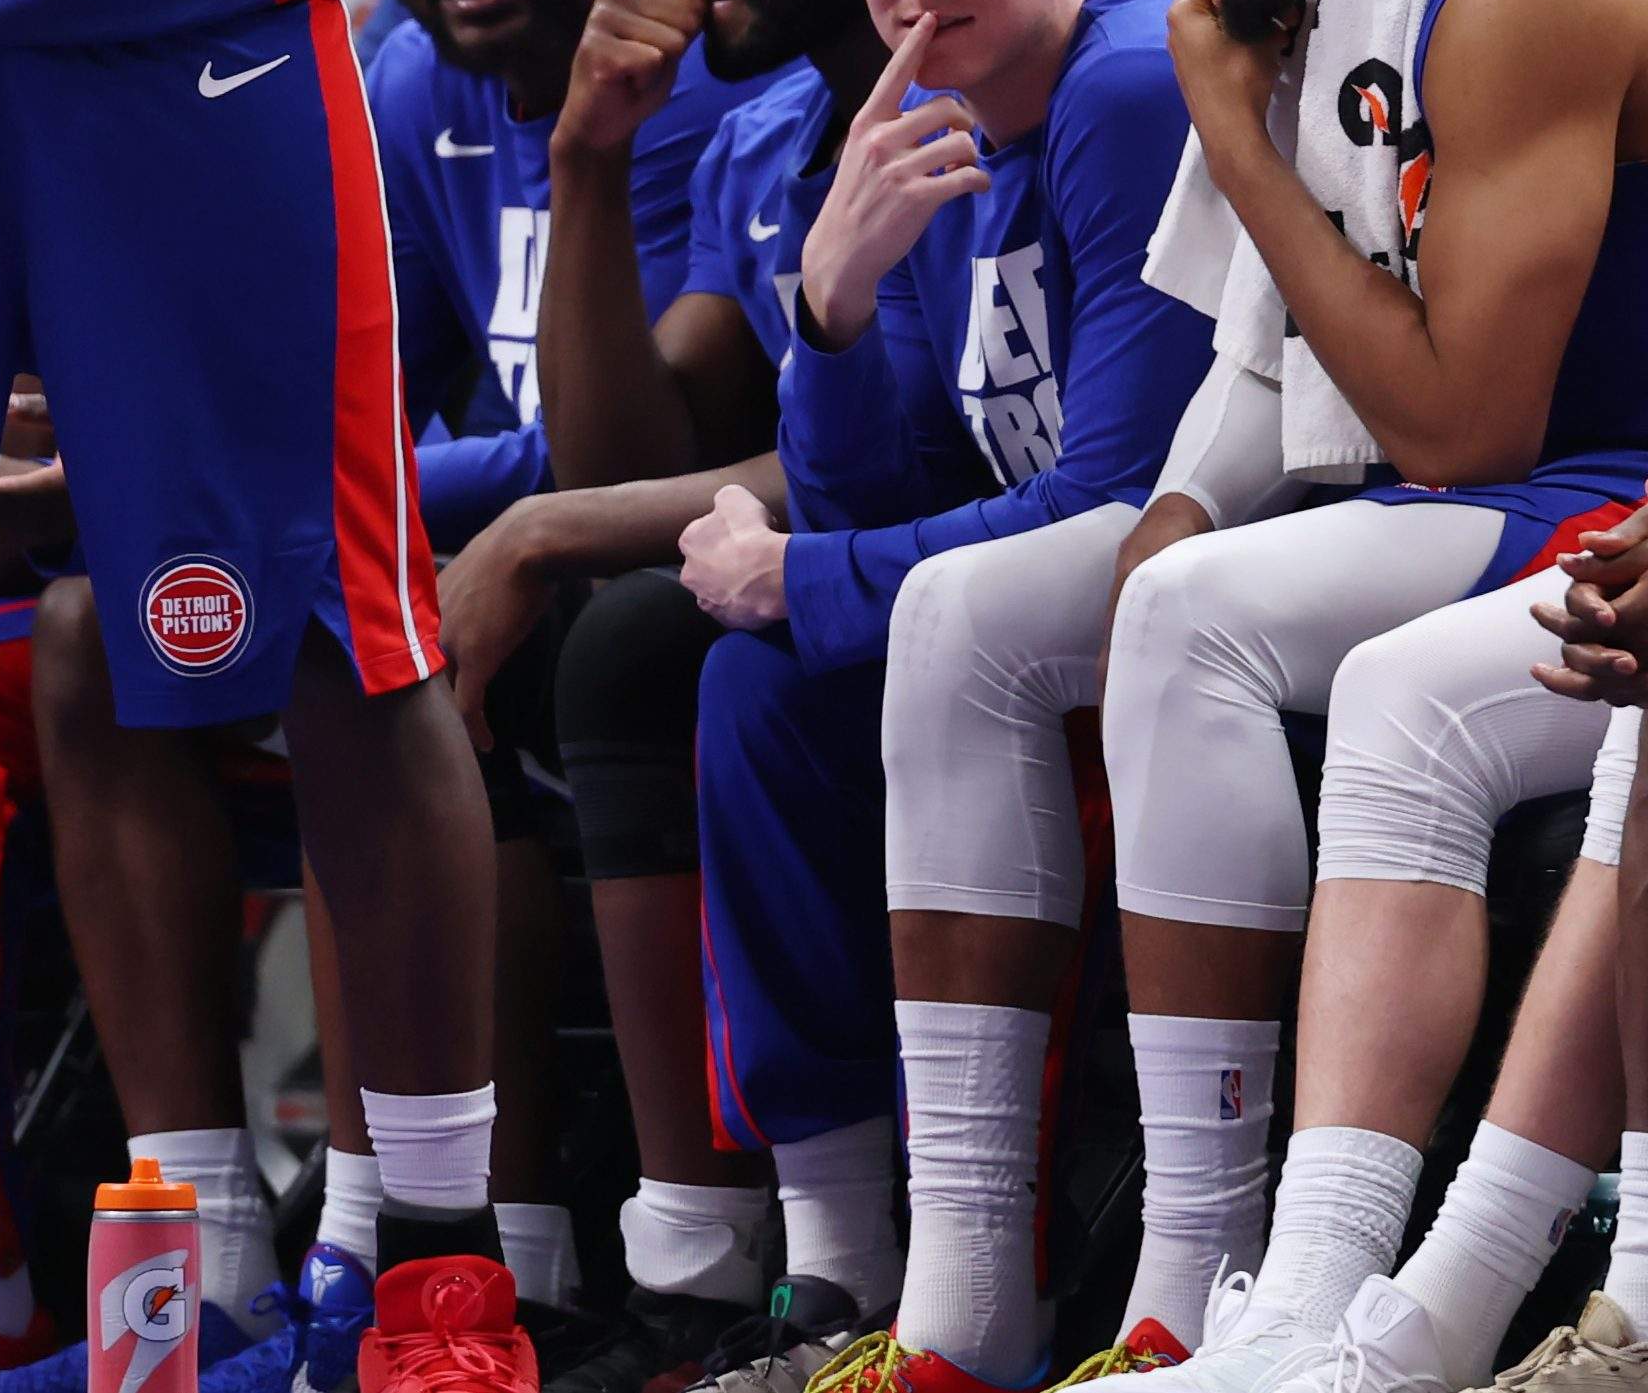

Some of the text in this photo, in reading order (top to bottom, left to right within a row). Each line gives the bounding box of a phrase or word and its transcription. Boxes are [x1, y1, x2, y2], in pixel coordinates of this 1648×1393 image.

[160, 594, 231, 616] DETROIT
[161, 613, 233, 635] PISTONS
[122, 1266, 187, 1344] G
